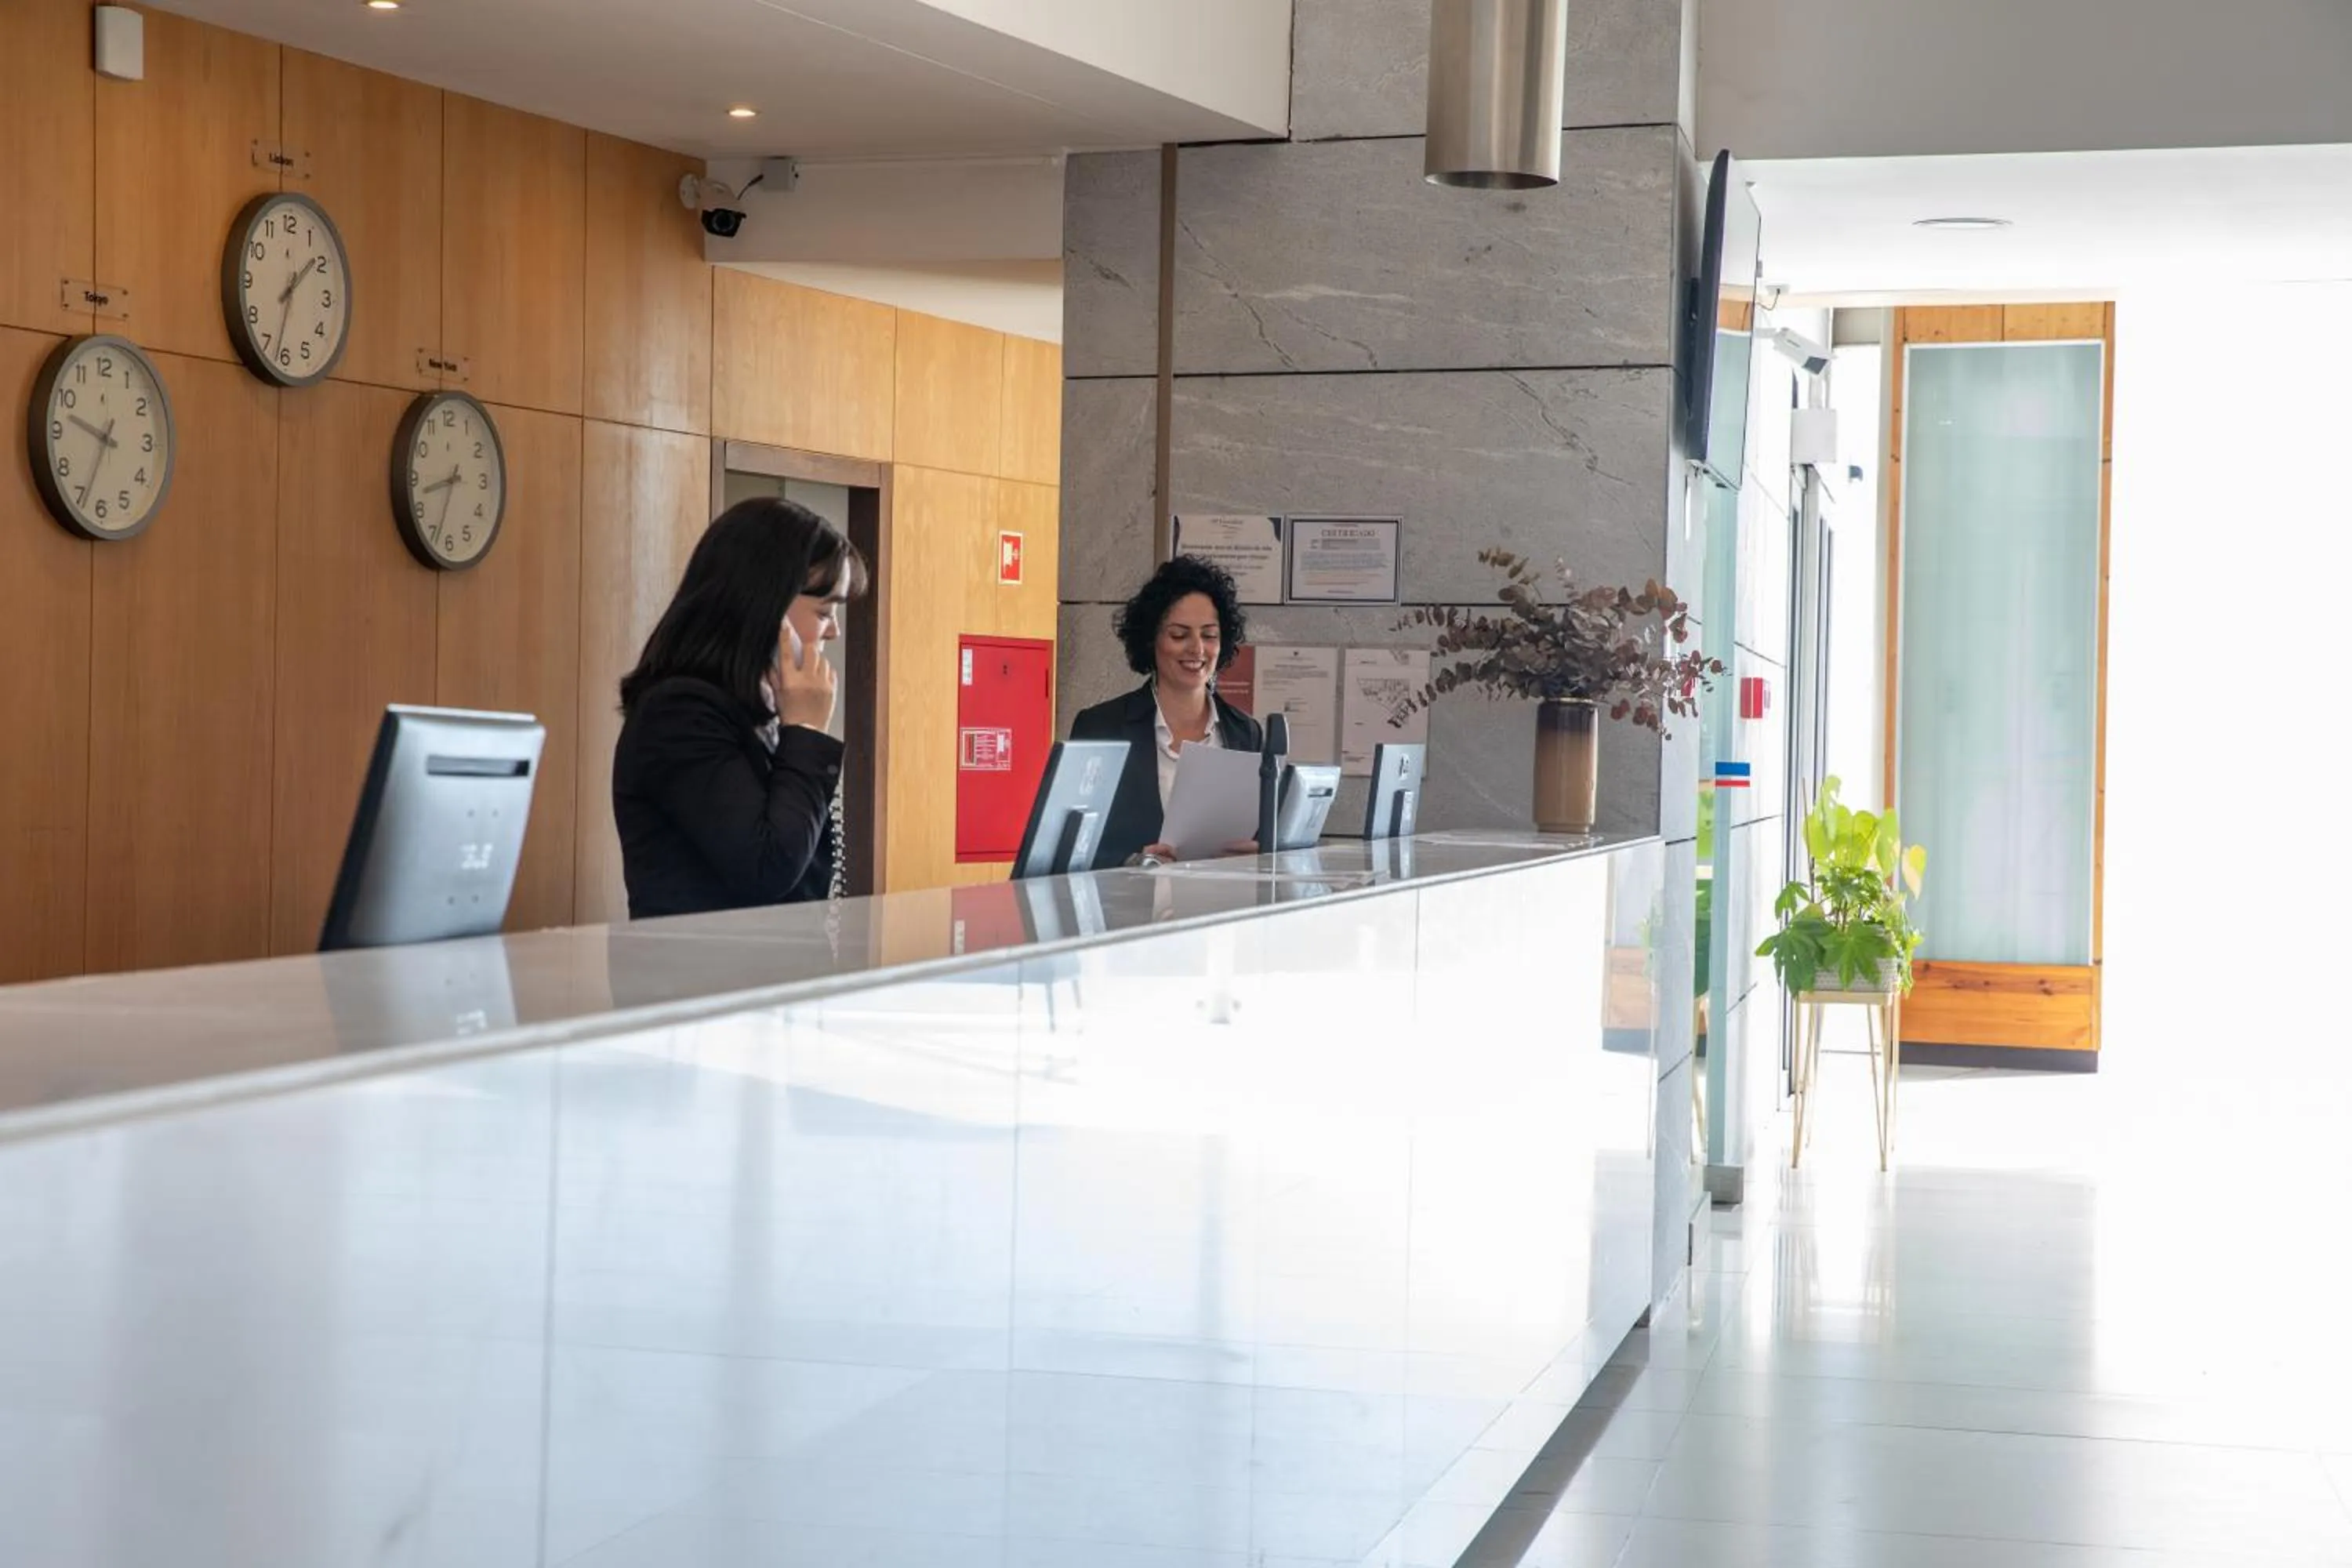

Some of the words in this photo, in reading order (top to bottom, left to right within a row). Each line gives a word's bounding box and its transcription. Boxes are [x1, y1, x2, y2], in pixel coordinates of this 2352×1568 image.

[265, 220, 274, 238] 11
[283, 215, 297, 234] 12
[250, 241, 265, 260] 10
[316, 256, 327, 273] 2
[242, 271, 252, 289] 9
[321, 290, 332, 307] 3
[248, 306, 258, 324] 8
[314, 321, 325, 337] 4
[261, 334, 271, 351] 7
[300, 342, 311, 359] 5
[280, 349, 290, 365] 6
[75, 365, 86, 384] 11
[96, 358, 112, 377] 12
[59, 389, 76, 408] 10
[135, 397, 147, 416] 2
[441, 410, 455, 426] 12
[51, 421, 63, 440] 9
[426, 419, 435, 436] 11
[142, 434, 153, 452] 3
[474, 441, 483, 458] 2
[58, 457, 70, 477] 8
[133, 467, 147, 485] 4
[478, 473, 488, 490] 3
[74, 486, 85, 505] 7
[118, 490, 129, 510] 5
[95, 499, 107, 518] 6
[416, 502, 425, 518] 8
[474, 503, 483, 517] 4
[428, 525, 437, 541] 7
[462, 525, 471, 542] 5
[445, 535, 454, 552] 6
